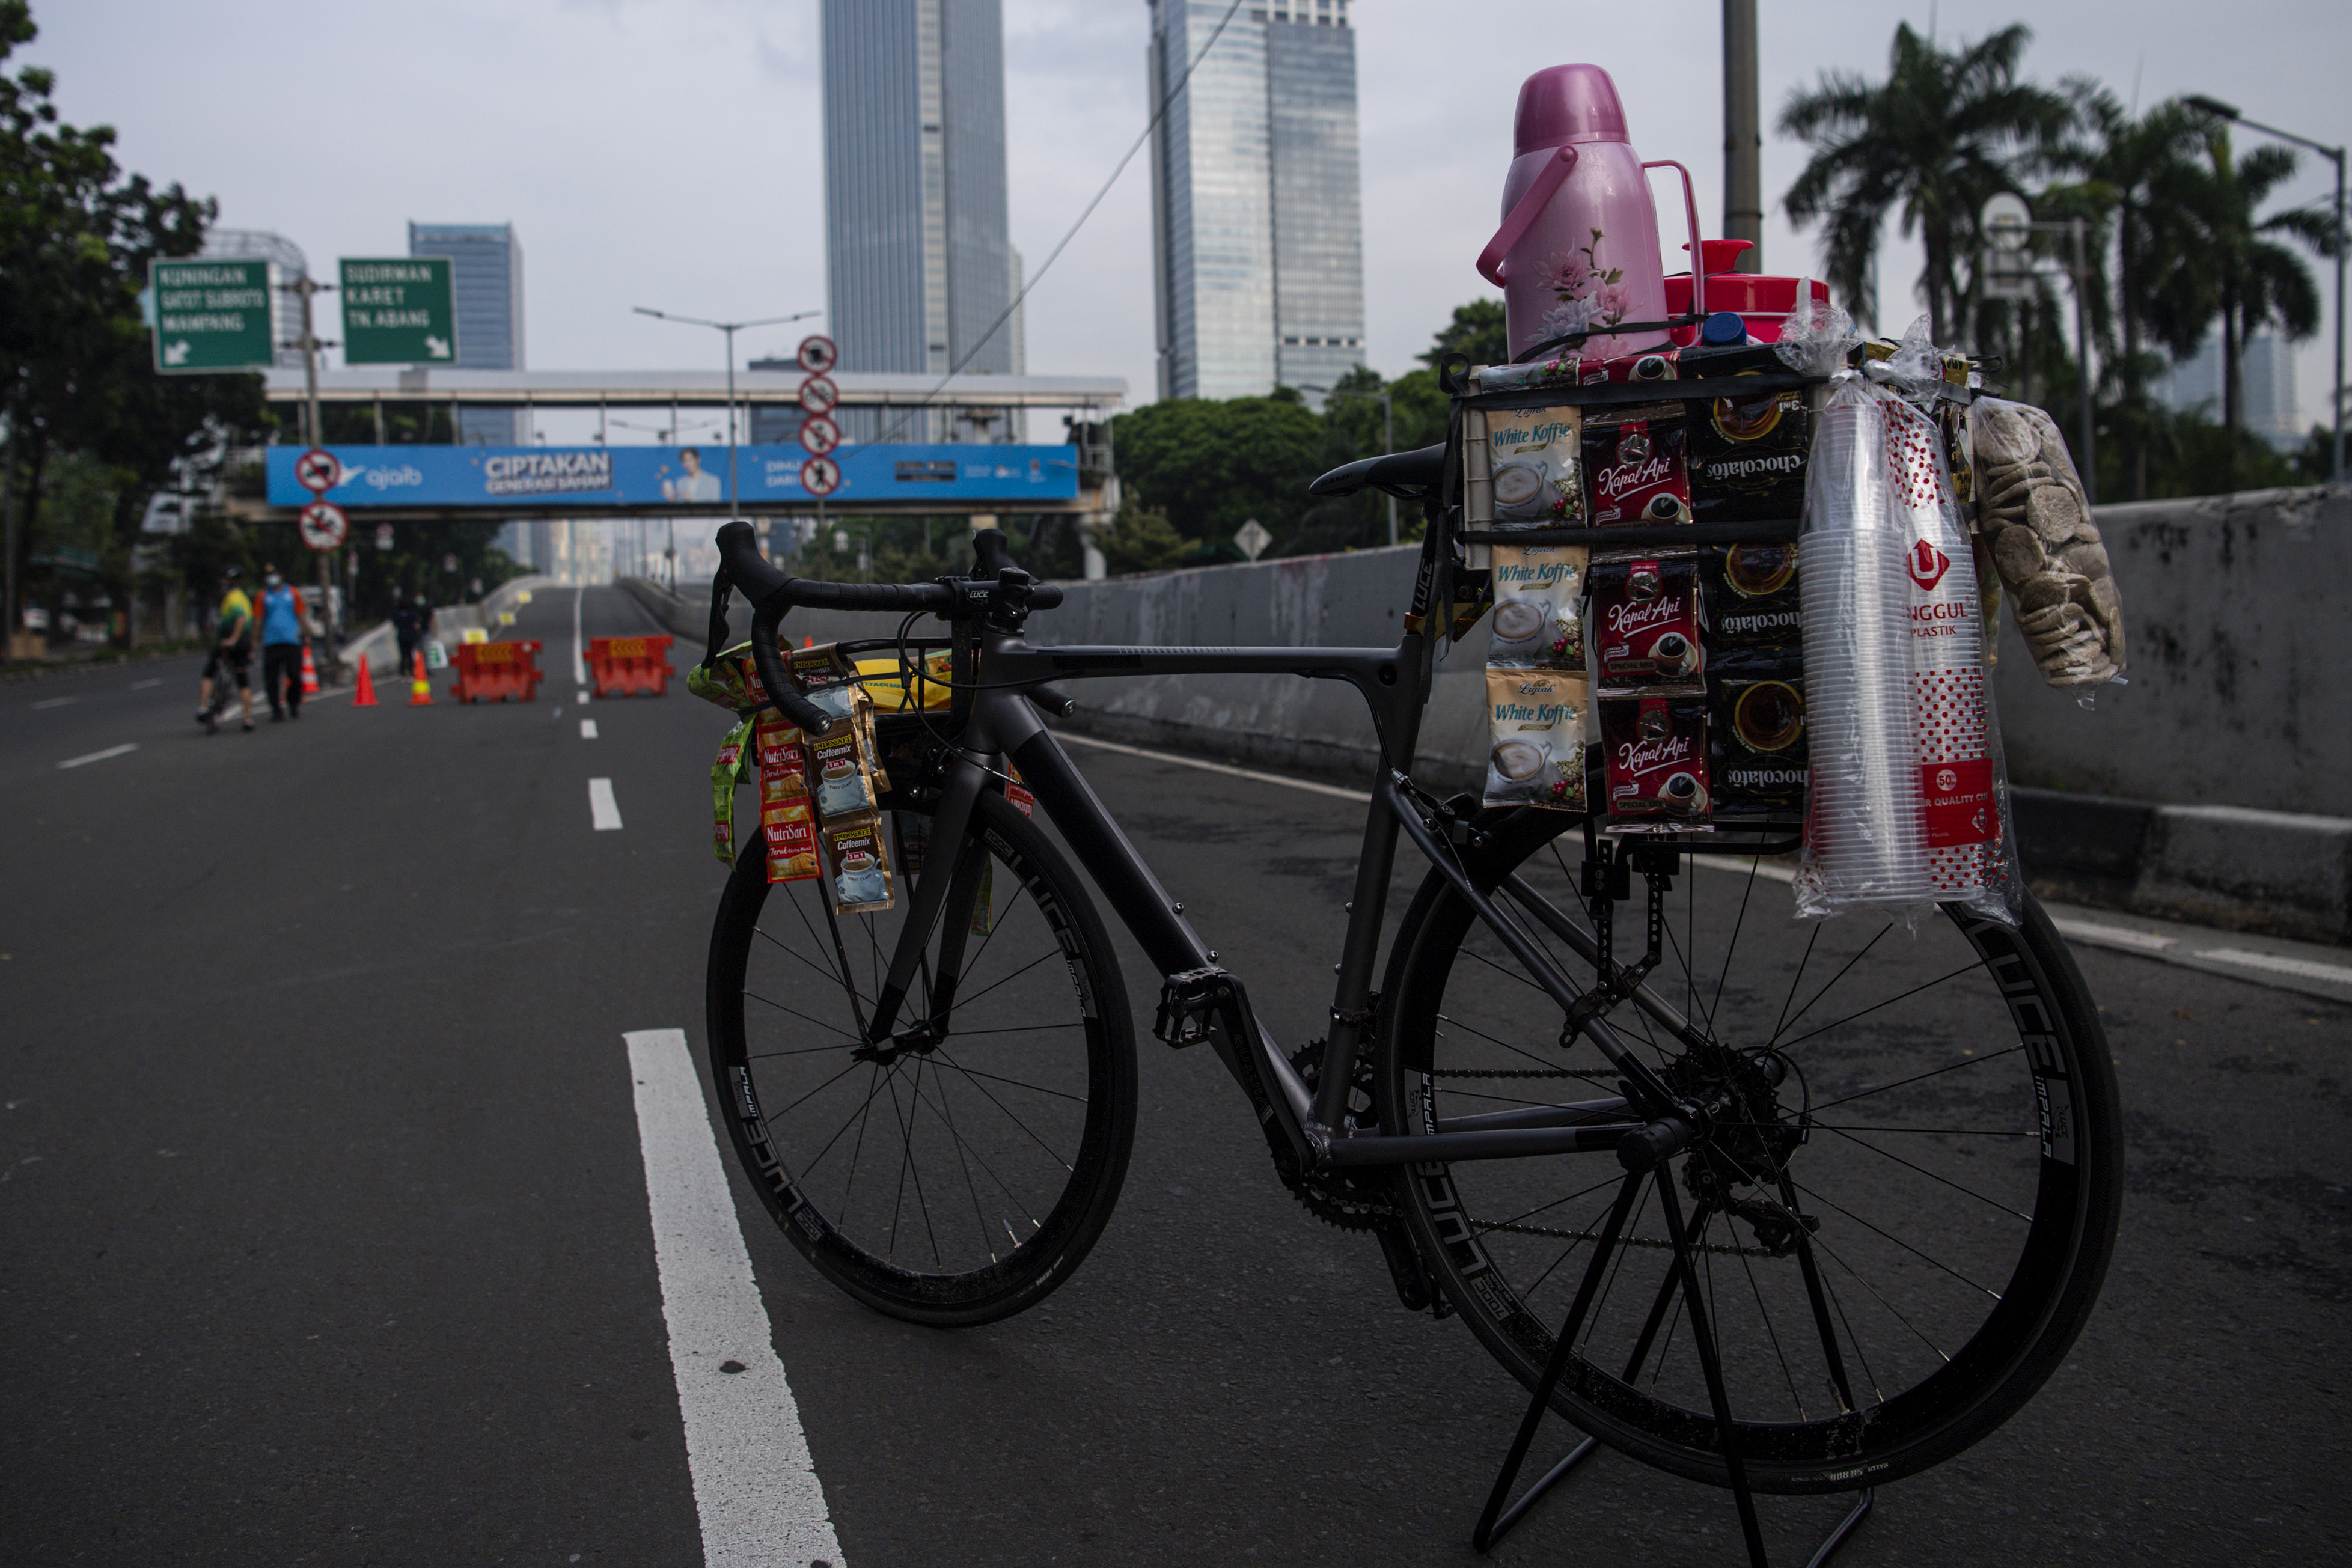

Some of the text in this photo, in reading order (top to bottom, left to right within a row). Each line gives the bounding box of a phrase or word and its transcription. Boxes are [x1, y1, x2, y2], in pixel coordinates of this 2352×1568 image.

[345, 264, 432, 284] SUDIRMAN
[346, 287, 403, 305] KARET
[1494, 423, 1569, 447] White Koffie
[486, 452, 609, 478] CIPTAKAN
[1598, 457, 1671, 496] Kapal Api
[1498, 563, 1577, 583] White Koffie
[1414, 557, 1434, 611] LUCE
[1608, 596, 1681, 633] Kapal Api
[1908, 603, 1968, 620] NGGUL
[1911, 626, 1956, 637] PLASTIK
[1517, 683, 1554, 695] Luwak
[1495, 703, 1576, 724] White Koffie
[764, 746, 799, 764] NutriSari
[817, 745, 851, 760] Coffeemix
[1619, 736, 1690, 772] Kapal Api
[1939, 775, 1952, 786] 50
[1934, 794, 1974, 807] QUALITY
[766, 826, 808, 842] NutriSari
[838, 837, 870, 850] Coffeemix
[1010, 853, 1080, 956] LUCE
[1965, 919, 2067, 1075] LUCE
[742, 1120, 804, 1214] LUCE
[1474, 1280, 1504, 1317] 700C
